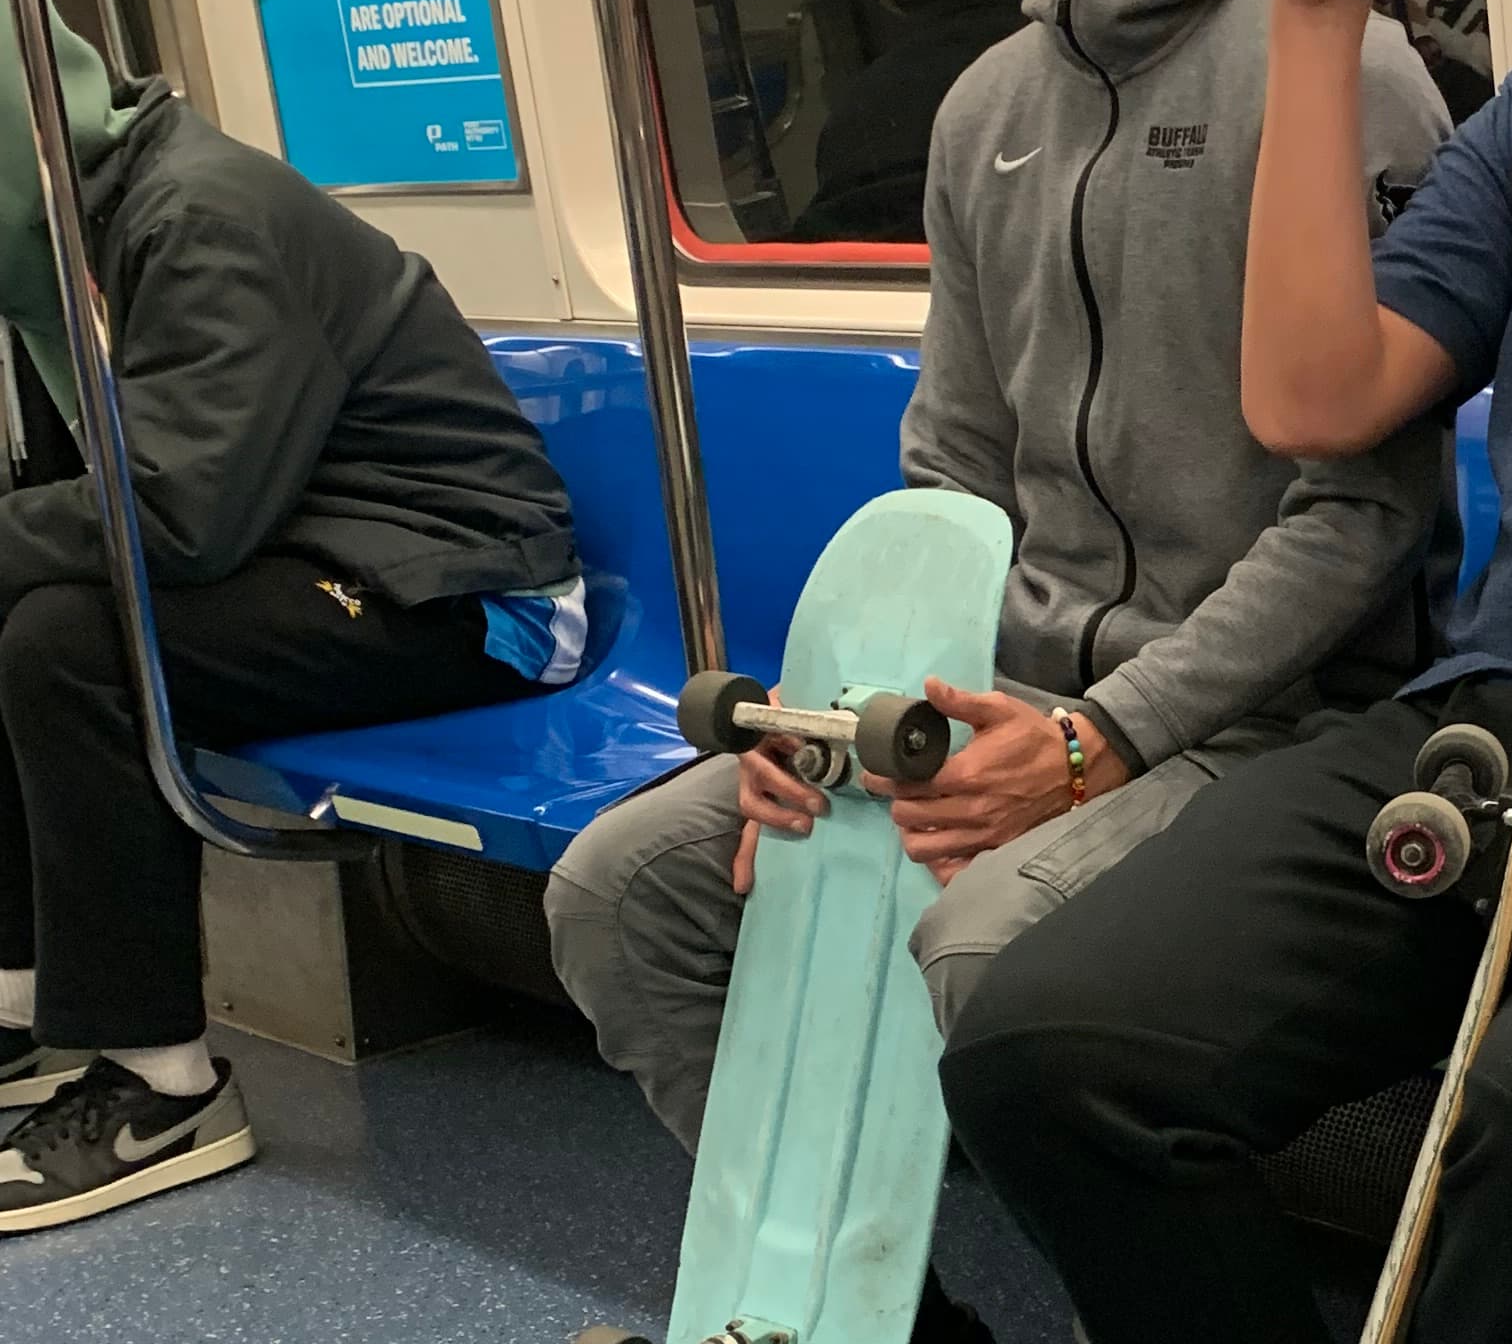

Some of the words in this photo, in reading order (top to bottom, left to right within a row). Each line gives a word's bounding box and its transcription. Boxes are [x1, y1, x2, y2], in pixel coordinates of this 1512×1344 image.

[351, 4, 382, 32] ARE
[357, 44, 391, 71] AND
[391, 37, 479, 69] WELCOME.
